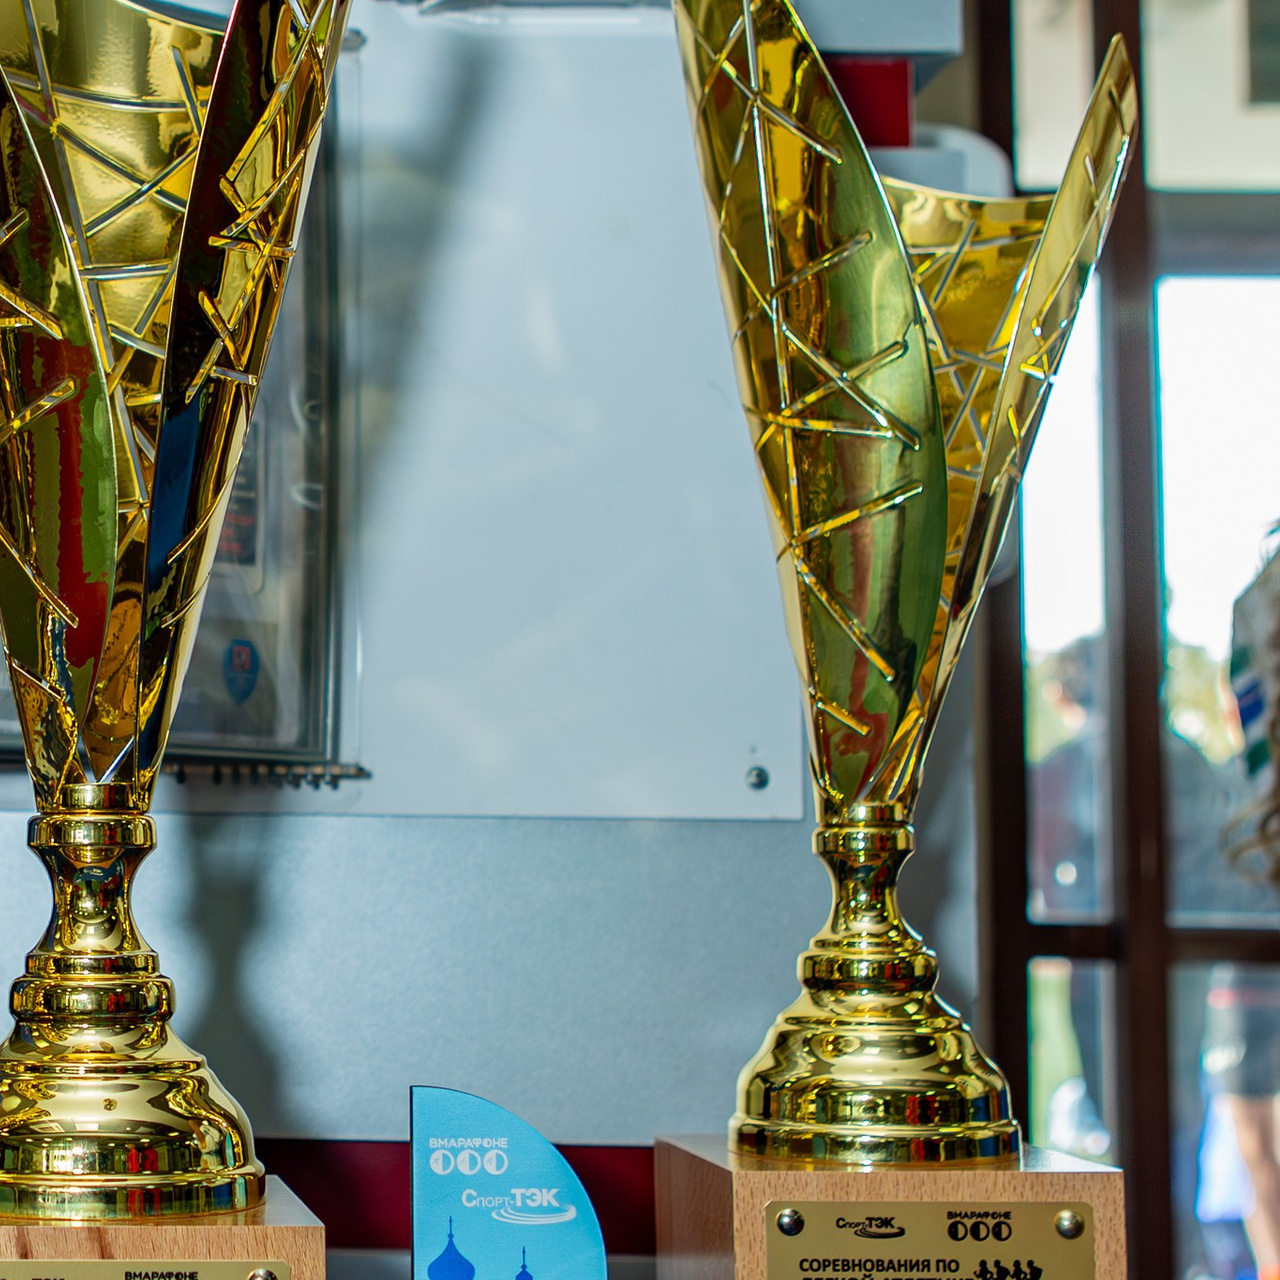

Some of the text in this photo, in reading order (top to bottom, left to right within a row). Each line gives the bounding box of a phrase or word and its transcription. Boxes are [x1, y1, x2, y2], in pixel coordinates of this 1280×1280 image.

[429, 1137, 509, 1149] ВМАРАФОНЕ
[461, 1188, 560, 1209] Спорт-ТЭК
[799, 1258, 960, 1273] СОРЕВНОВАНИЯ ПО
